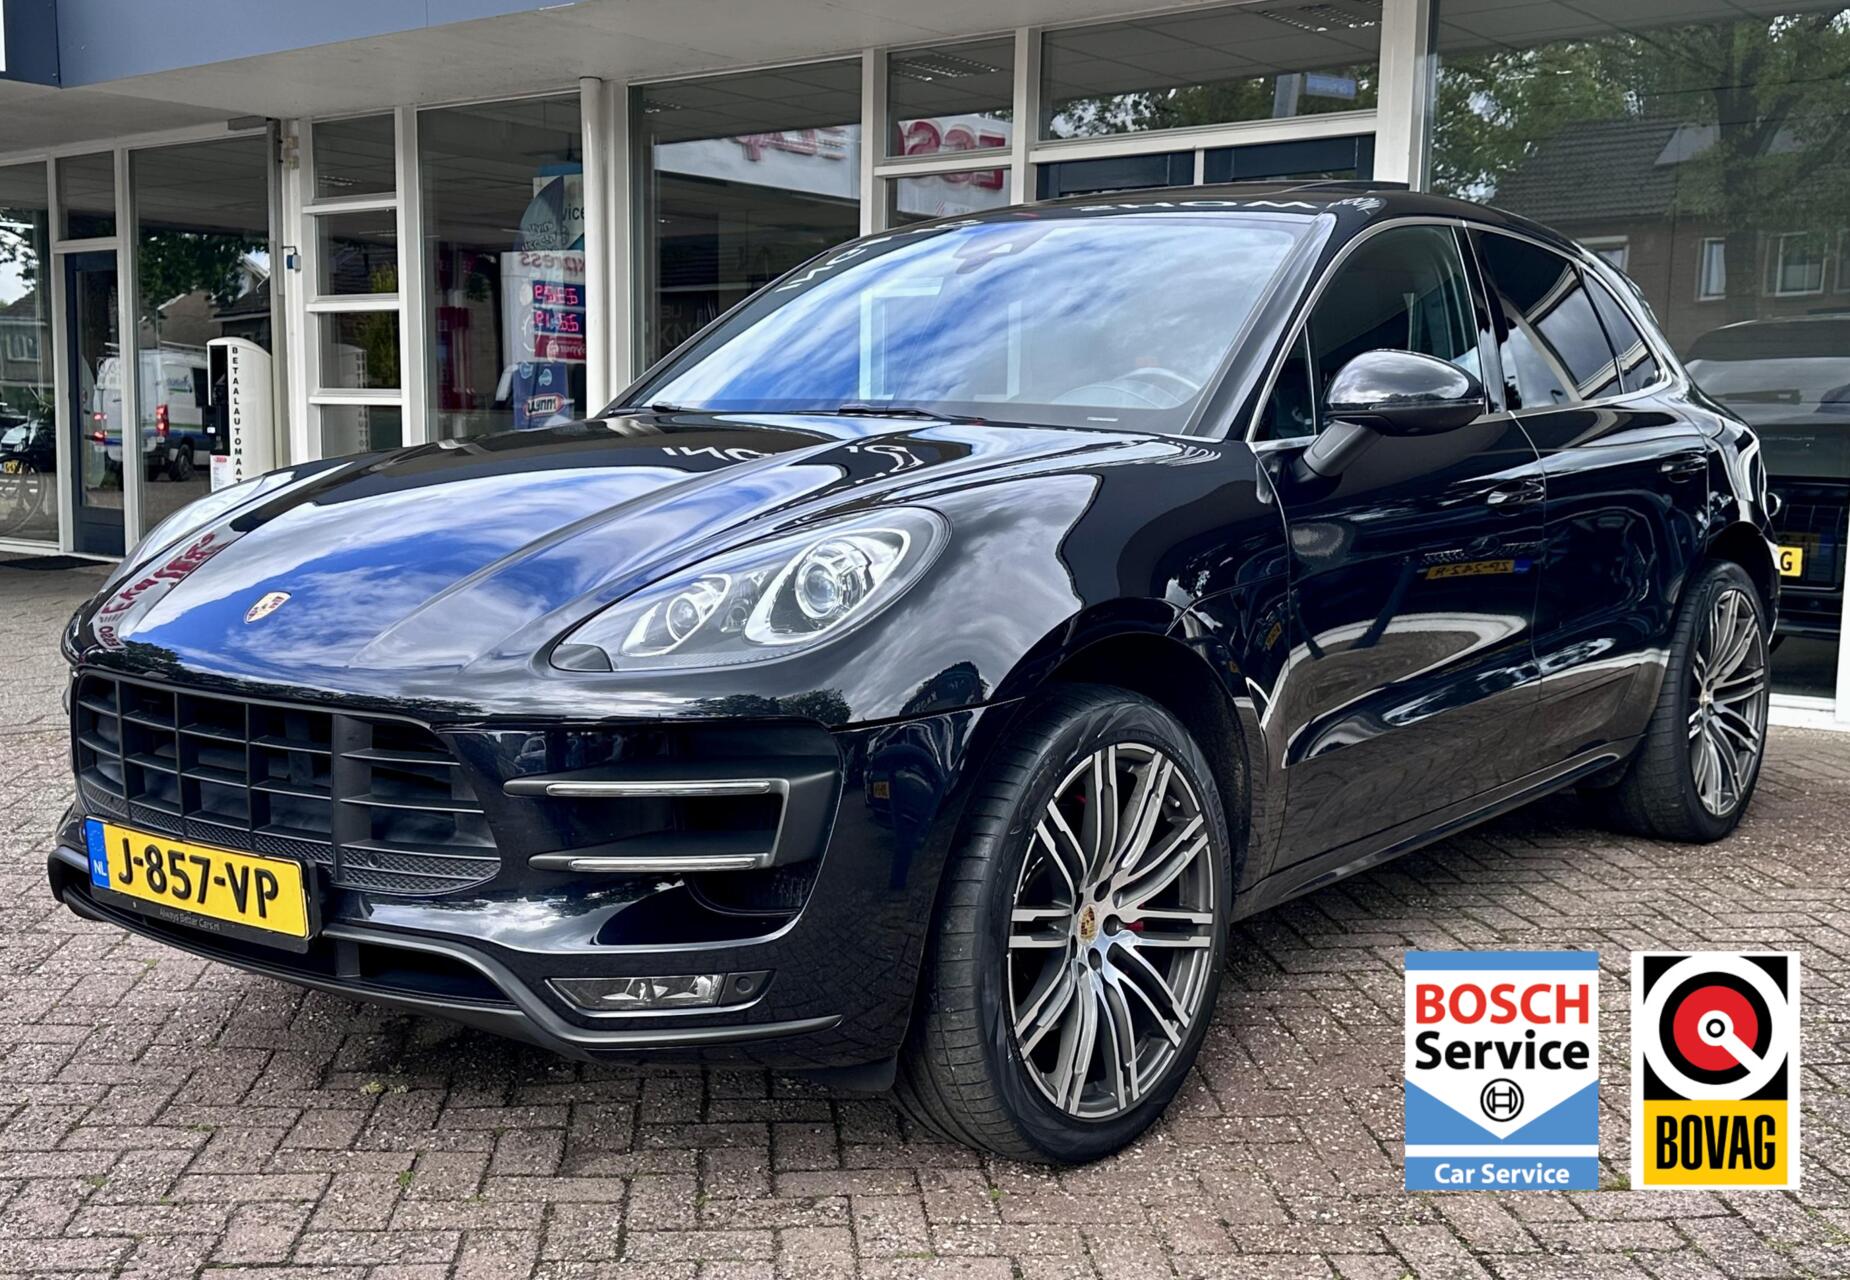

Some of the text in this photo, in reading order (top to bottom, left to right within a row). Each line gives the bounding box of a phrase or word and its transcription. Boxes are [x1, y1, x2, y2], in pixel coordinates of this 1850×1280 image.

[232, 347, 243, 484] BETAALAUTOMAAT
[94, 860, 107, 877] NL
[118, 837, 279, 919] J-857-VP
